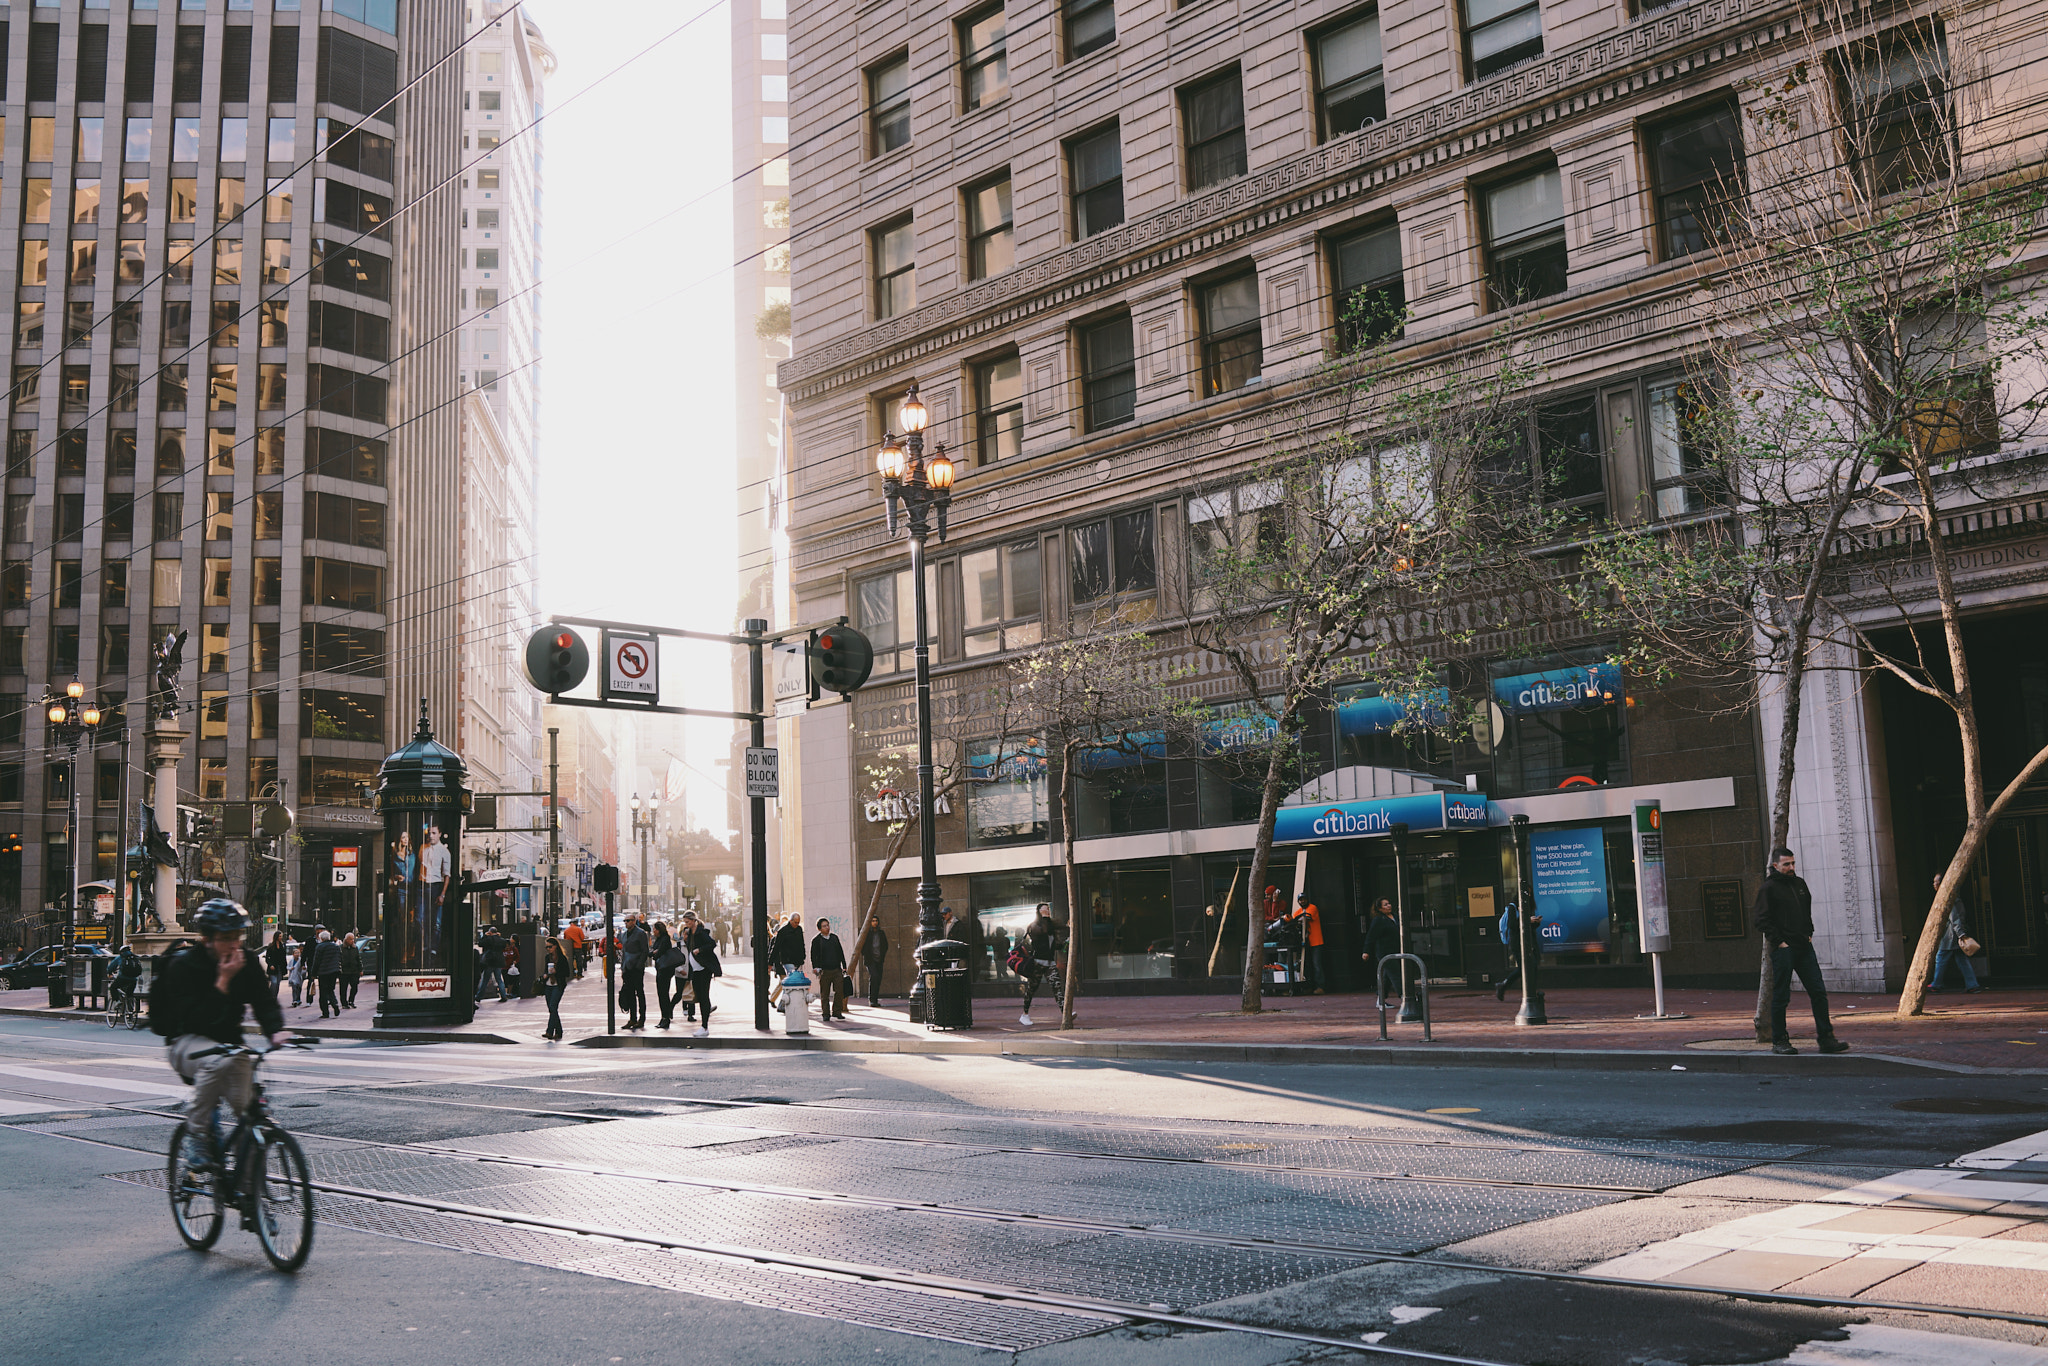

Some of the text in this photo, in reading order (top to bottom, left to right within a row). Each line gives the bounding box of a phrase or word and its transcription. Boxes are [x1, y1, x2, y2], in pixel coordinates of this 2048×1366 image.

[1861, 543, 2041, 586] HOBART BUILDING
[613, 680, 653, 691] EXCEPT MUNI
[777, 678, 802, 694] ONLY
[1519, 674, 1602, 707] citibank
[747, 754, 777, 766] DO NOT
[748, 770, 777, 782] BLOCK
[748, 784, 778, 793] INTERSECTION
[390, 795, 452, 804] SAN FRANCISCO
[1448, 802, 1486, 820] citibank
[1312, 807, 1393, 835] citibank
[1548, 852, 1563, 860] $500
[336, 870, 346, 882] b
[1555, 868, 1591, 876] Management.
[1541, 924, 1561, 938] citi
